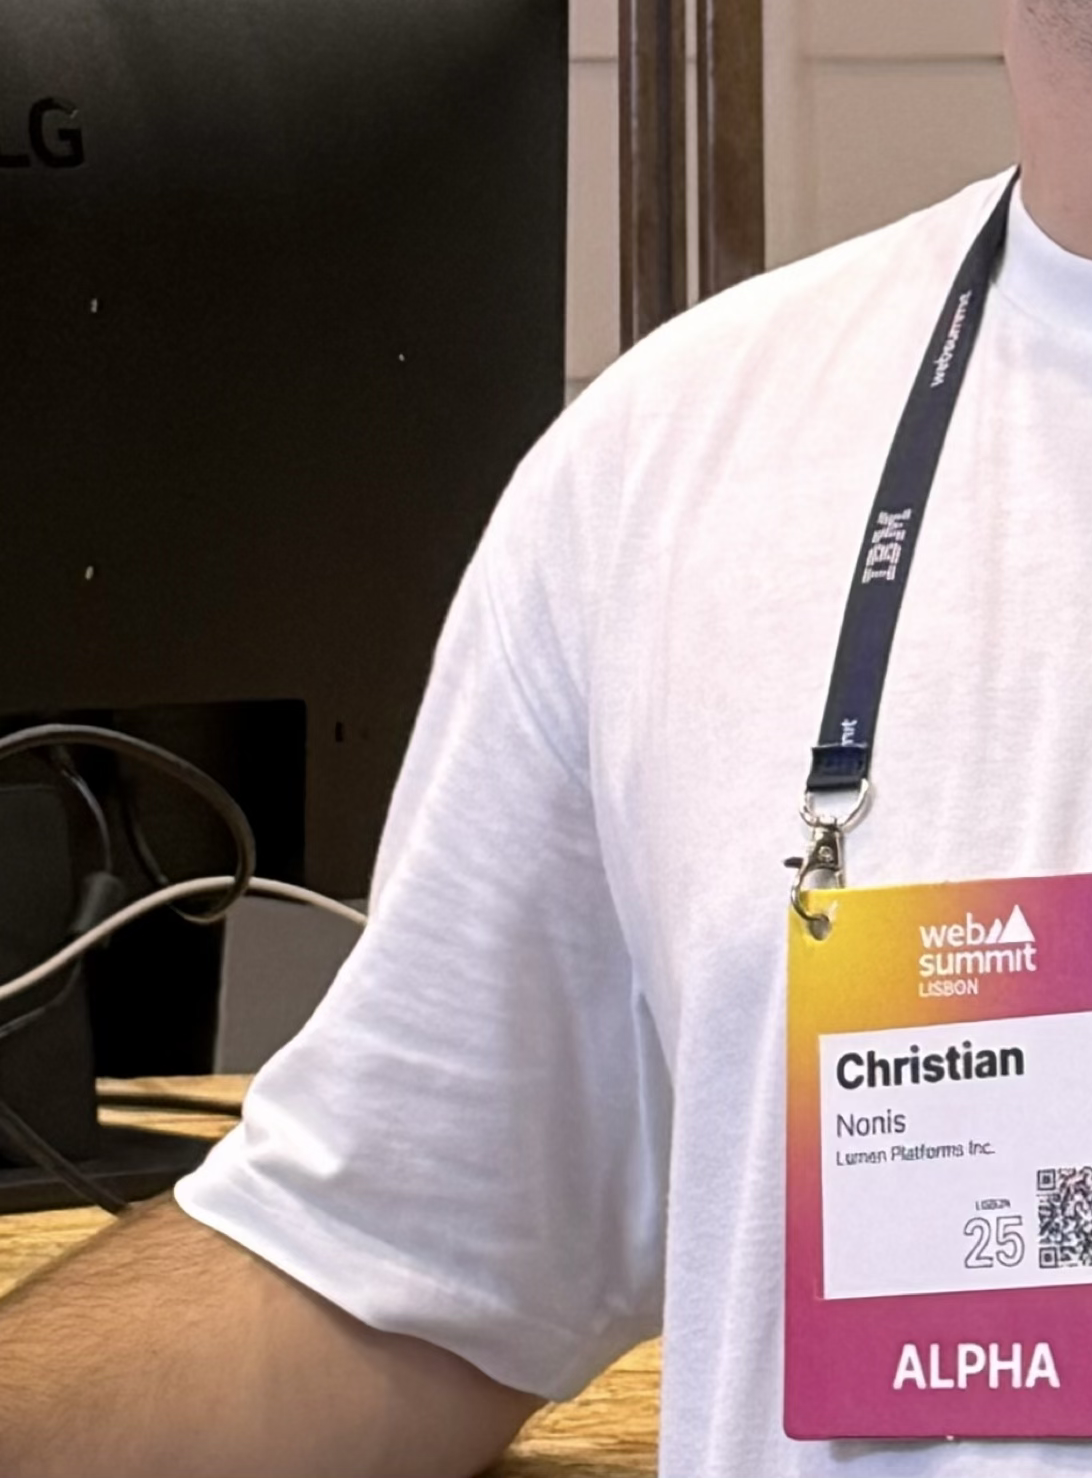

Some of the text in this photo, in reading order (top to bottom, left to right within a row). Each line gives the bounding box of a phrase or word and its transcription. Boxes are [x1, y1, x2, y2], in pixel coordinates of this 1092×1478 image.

[862, 508, 912, 584] IBM
[919, 913, 986, 948] web
[918, 942, 1037, 977] summit
[918, 978, 979, 998] LISBON
[835, 1040, 1025, 1090] Christian
[836, 1108, 907, 1138] Nonis
[891, 1143, 965, 1163] Platforms
[963, 1215, 1026, 1269] 25
[892, 1341, 1061, 1390] ALPHA
